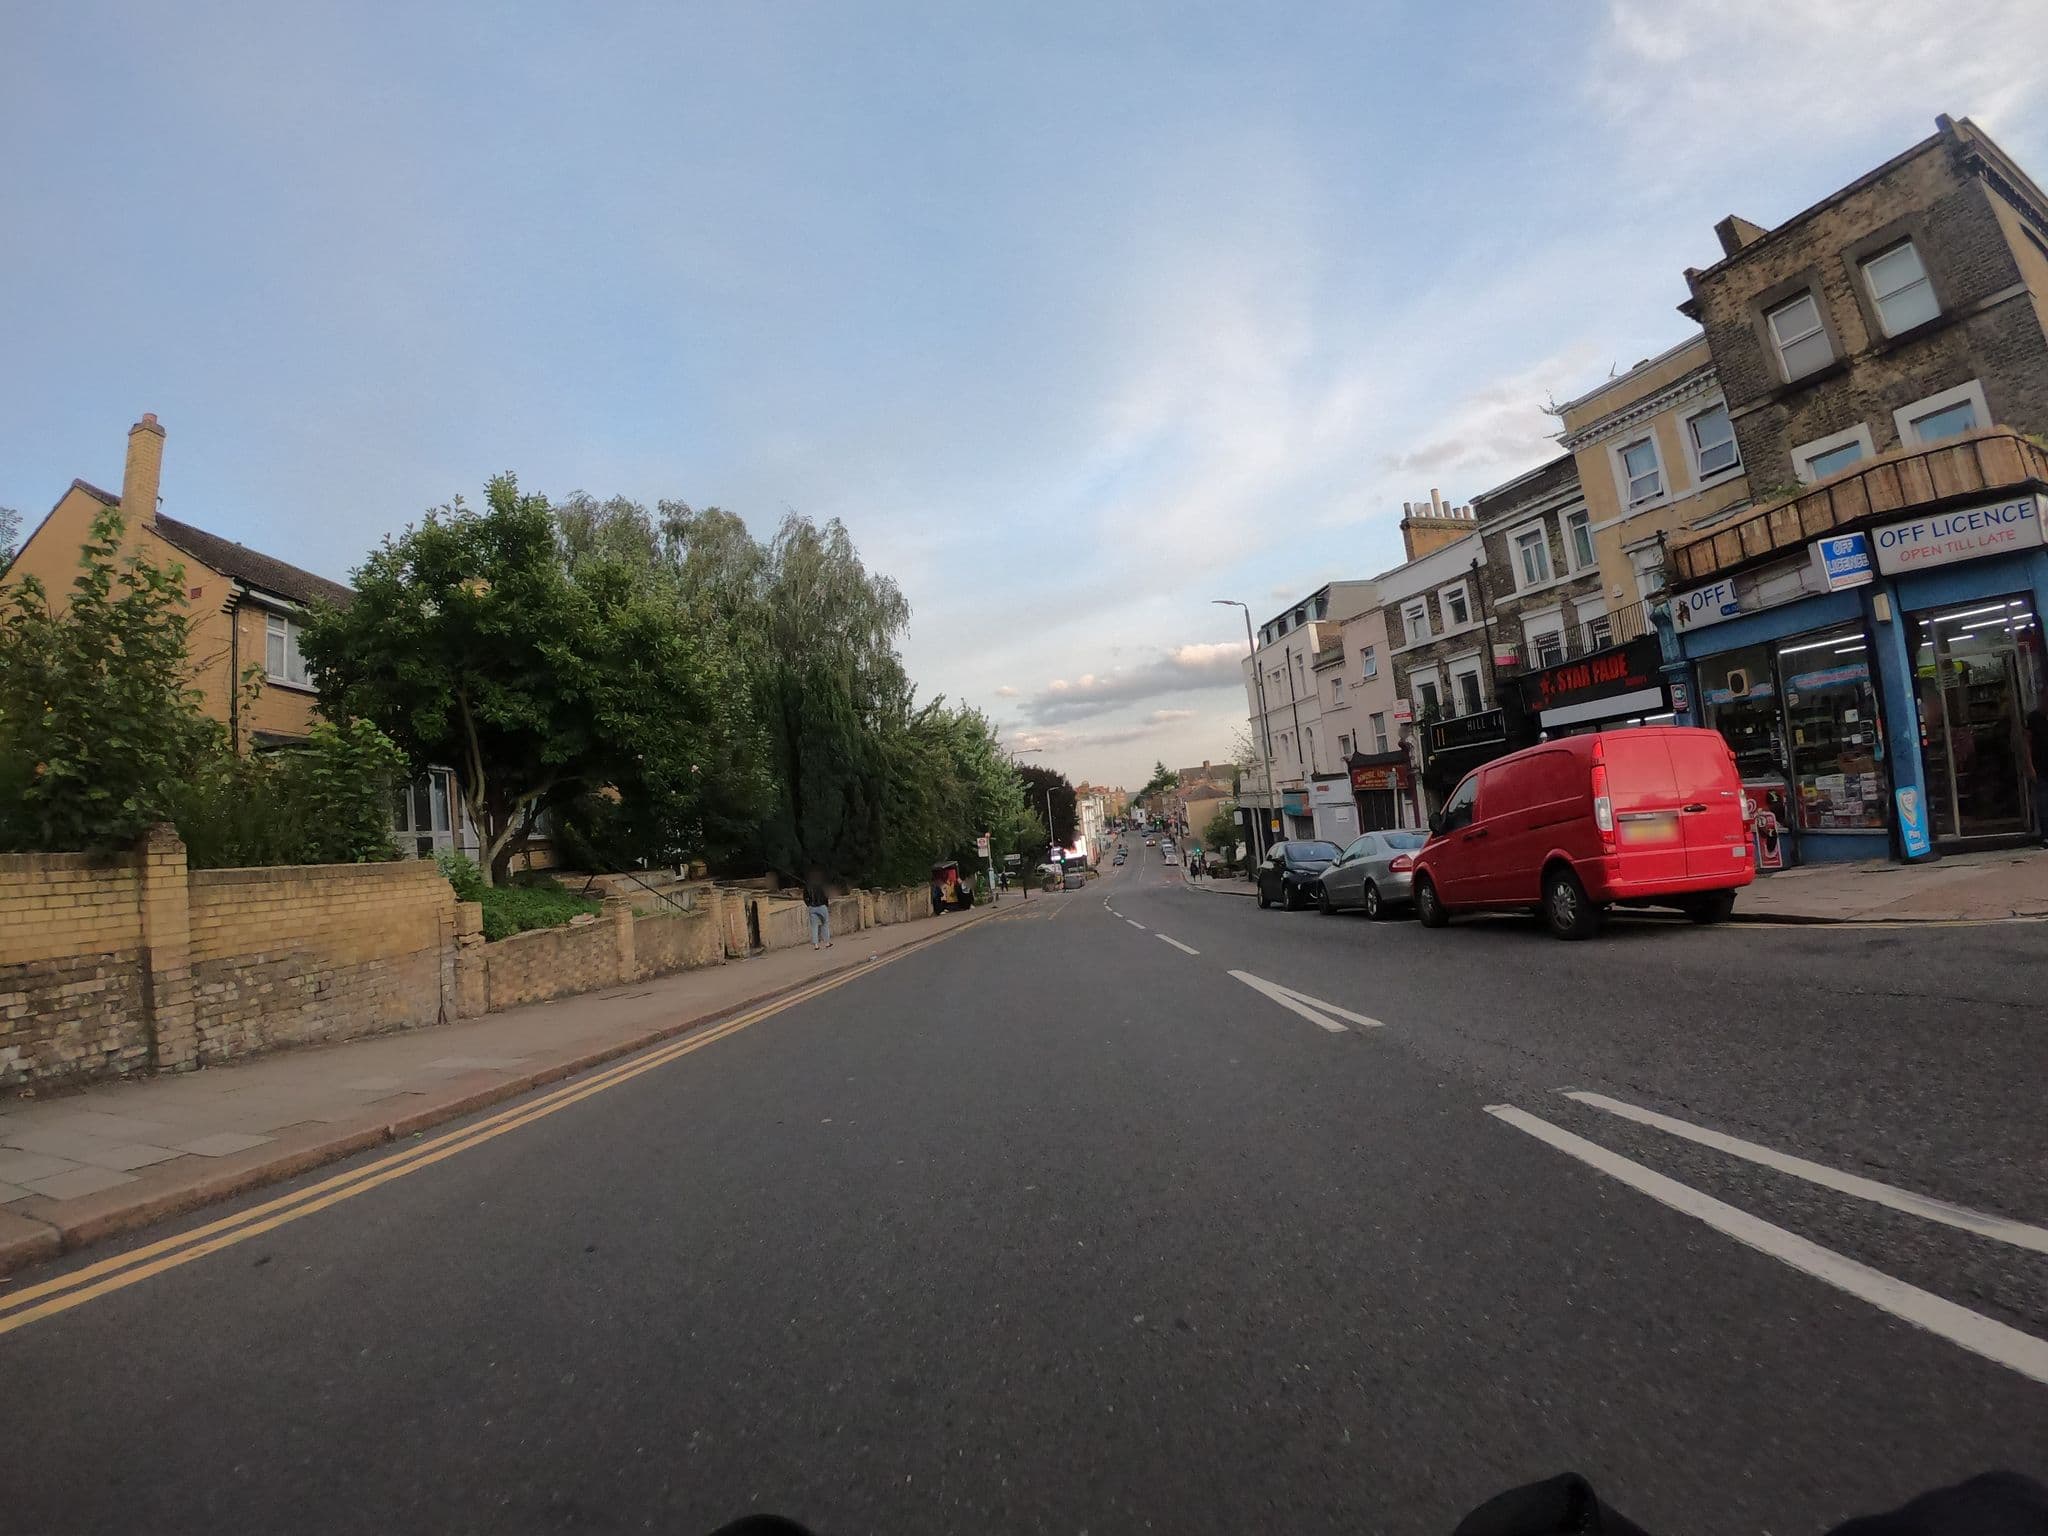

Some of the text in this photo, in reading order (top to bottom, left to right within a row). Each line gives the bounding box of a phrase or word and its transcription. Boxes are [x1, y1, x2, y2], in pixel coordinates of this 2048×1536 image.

[1880, 501, 2035, 548] OFF LICENCE
[1832, 539, 1854, 556] OFF
[1899, 529, 2016, 562] OPEN TILL LATE
[1826, 552, 1870, 574] LICENCE
[1690, 584, 1725, 611] OFF
